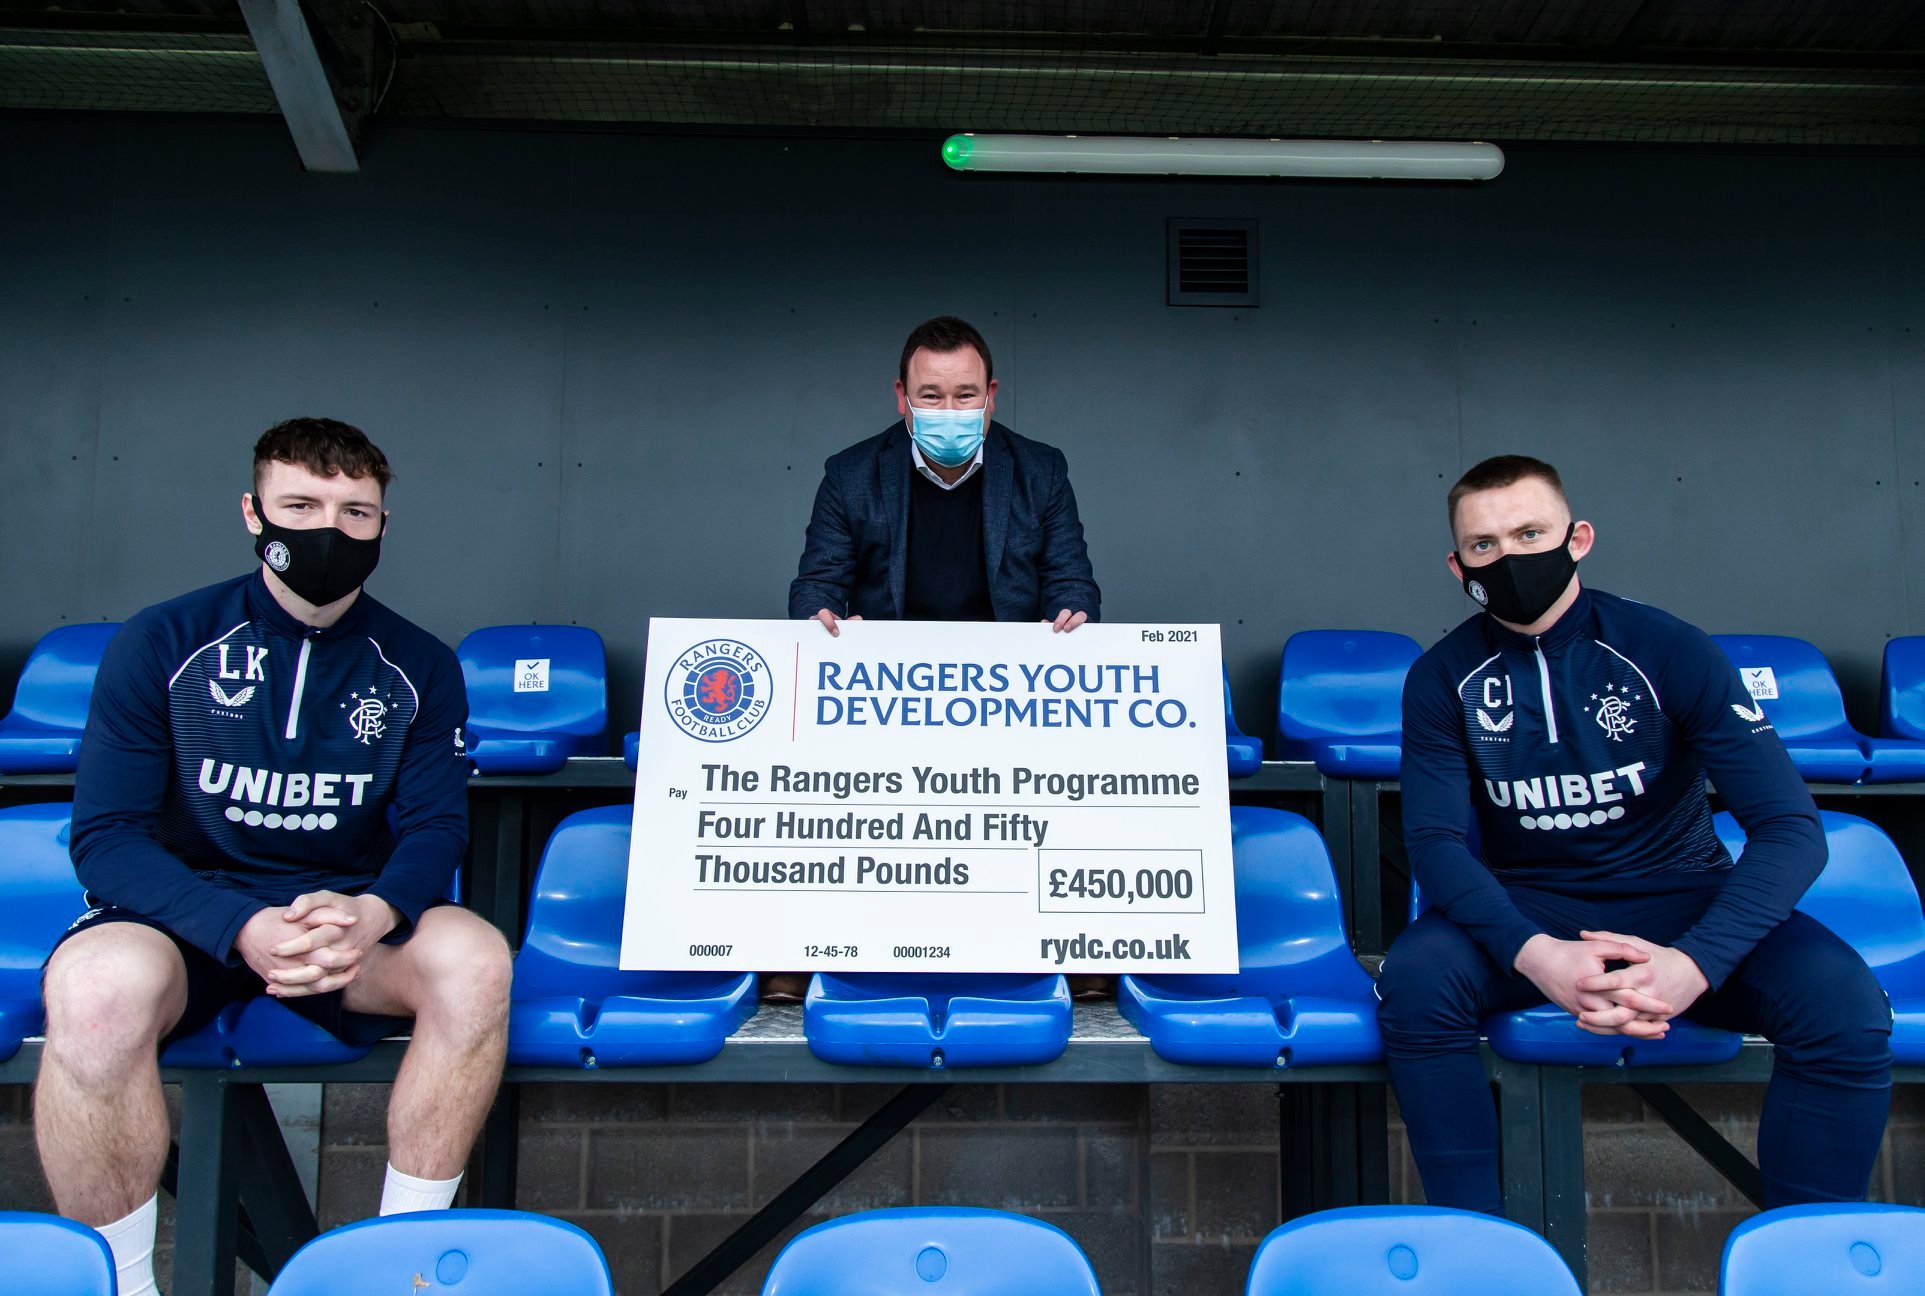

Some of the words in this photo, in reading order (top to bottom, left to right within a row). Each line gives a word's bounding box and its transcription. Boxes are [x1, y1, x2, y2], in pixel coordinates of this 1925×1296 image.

[1141, 630, 1164, 642] Feb
[1167, 630, 1198, 643] 2021
[679, 643, 763, 672] RANGERS
[518, 680, 545, 689] HERE
[524, 672, 540, 681] OK
[817, 661, 1010, 693] RANGERS
[1018, 664, 1160, 693] YOUTH
[1752, 680, 1768, 689] OK
[1748, 687, 1774, 696] HERE
[671, 698, 736, 738] FOOTBALL
[736, 699, 766, 730] CLUB
[703, 714, 732, 724] READY
[816, 696, 1117, 728] DEVELOPMENT
[1128, 698, 1196, 729] CO.
[198, 758, 374, 808] UNIBET
[669, 787, 688, 800] Pay
[701, 764, 759, 792] The
[769, 765, 903, 799] Rangers
[911, 766, 1001, 794] Youth
[1012, 767, 1200, 801] Programme
[1484, 760, 1646, 810] UNIBET
[697, 810, 766, 839] Four
[775, 811, 904, 840] Hundred
[912, 812, 973, 841] And
[984, 813, 1049, 847] Fifty
[695, 854, 845, 884] Thousand
[856, 856, 970, 885] Pounds
[1048, 868, 1193, 905] £450,000
[689, 944, 733, 957] 000007
[804, 945, 858, 958] 12-45-78
[893, 946, 951, 959] 00001234
[1041, 933, 1192, 965] rydc.co.uk
